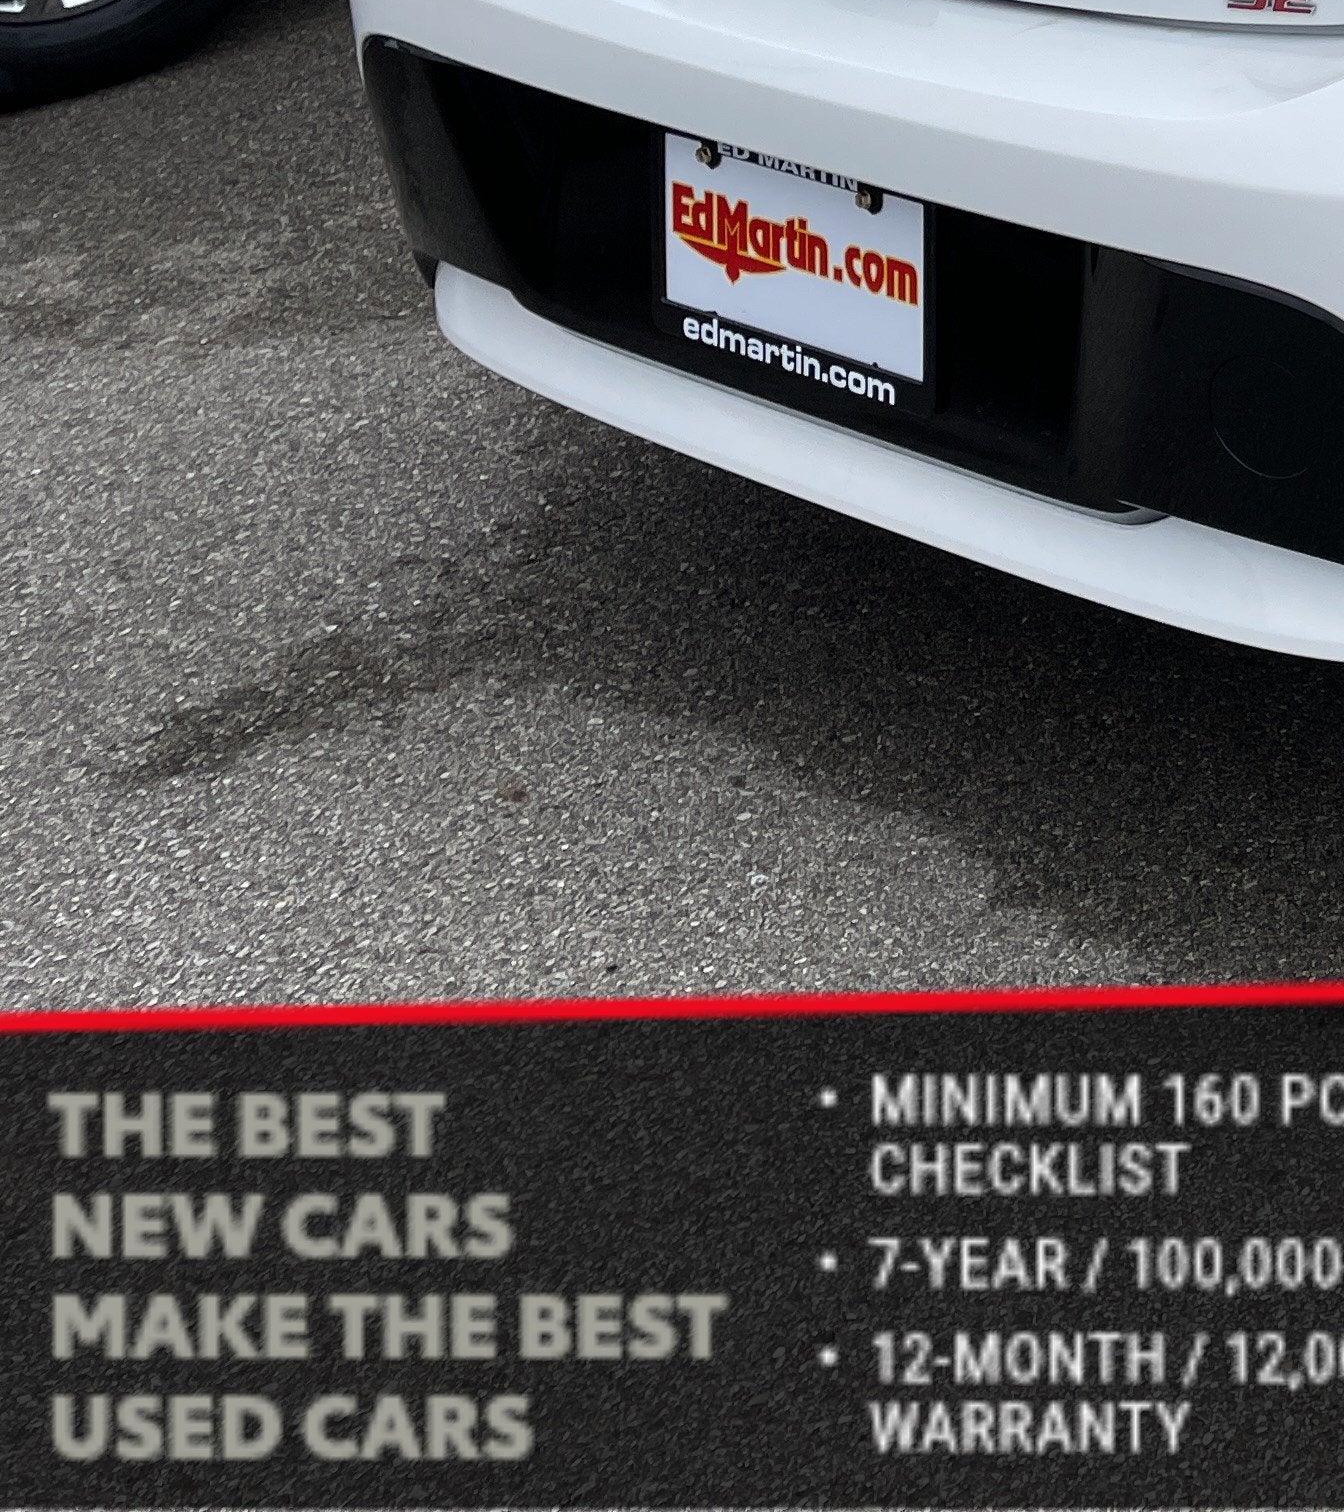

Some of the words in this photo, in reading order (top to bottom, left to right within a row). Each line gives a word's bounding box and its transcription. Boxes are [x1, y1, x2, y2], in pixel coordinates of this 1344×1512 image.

[715, 141, 751, 161] ED
[757, 154, 859, 193] MARTIN
[671, 181, 919, 307] EdMartin.com
[682, 315, 897, 407] edmartin.com
